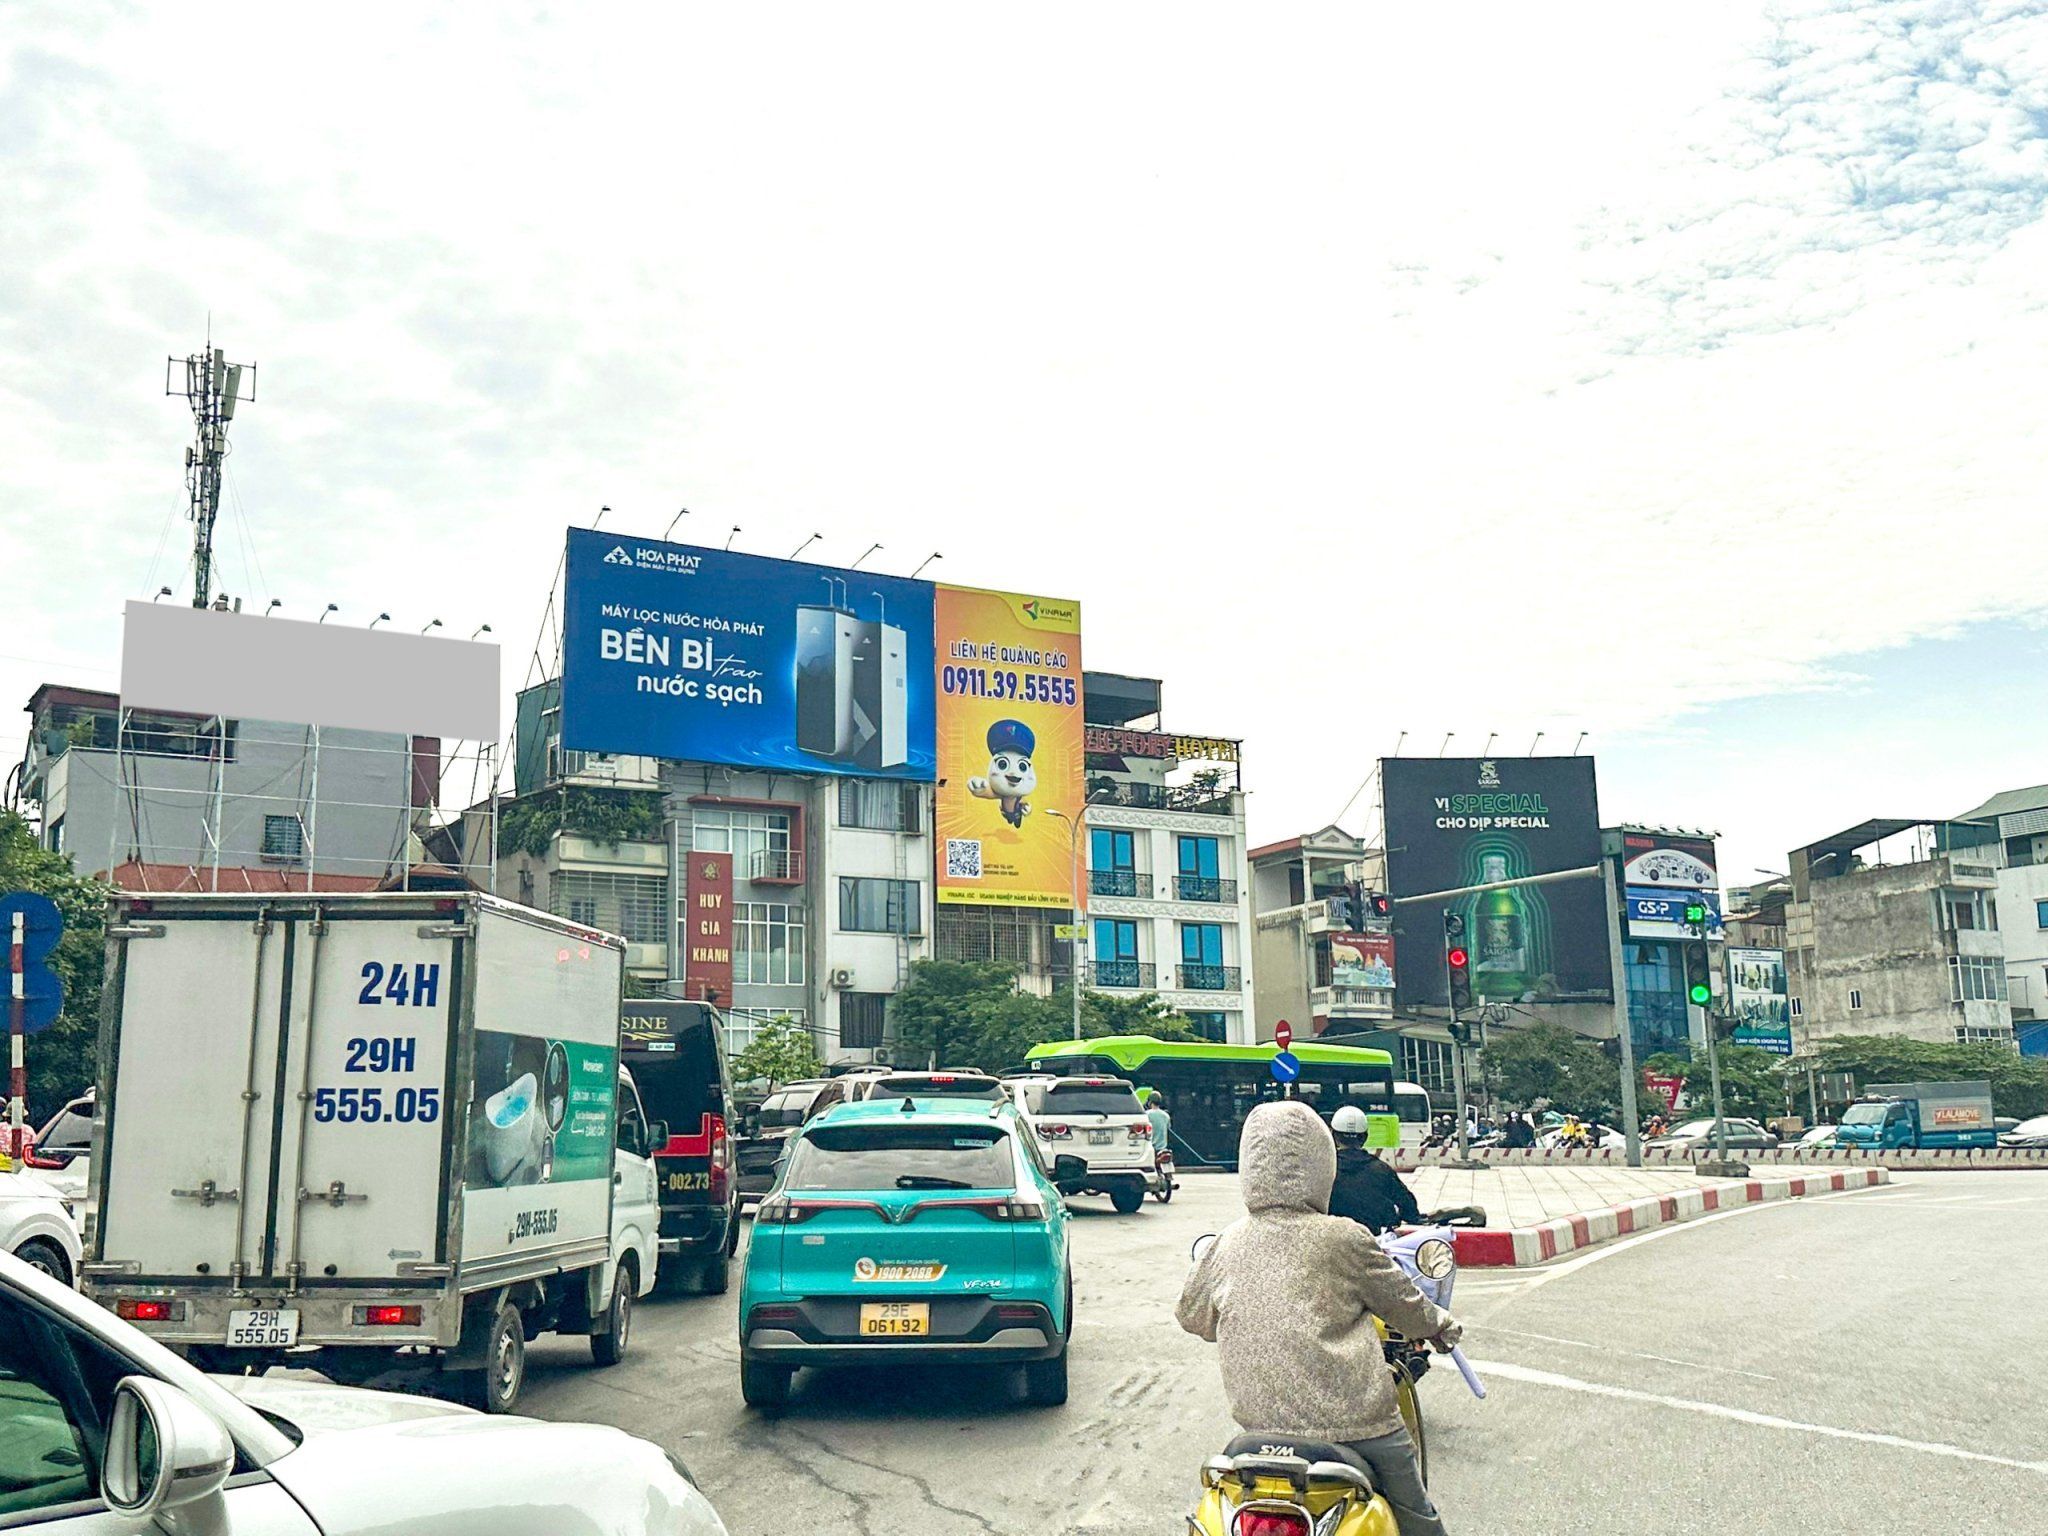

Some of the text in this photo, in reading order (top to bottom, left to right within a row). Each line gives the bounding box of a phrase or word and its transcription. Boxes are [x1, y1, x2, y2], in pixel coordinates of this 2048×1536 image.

[602, 603, 765, 637] MÁY LỌC NƯỚC HÒA PHÁT
[601, 626, 713, 671] BỀN BỈ
[950, 639, 1067, 669] LIÊN HỆ QUẢNG CÁO
[712, 653, 764, 680] trao
[637, 674, 763, 707] nước sạch
[942, 665, 1076, 706] 0911.39.5555
[1434, 793, 1549, 814] VỊ SPECIAL
[1435, 816, 1550, 832] CHO DỊP SPECIAL
[699, 893, 722, 909] HUY
[700, 920, 721, 935] GIA
[358, 961, 440, 1007] 24H
[344, 1037, 416, 1073] 29H
[314, 1087, 439, 1123] 555.05
[669, 1172, 710, 1190] 002.73
[515, 1207, 558, 1239] 29H-555.05
[877, 1266, 903, 1280] 1900
[248, 1311, 279, 1327] 29H
[868, 1318, 921, 1334] 061.92
[234, 1328, 290, 1344] 555.05
[1258, 1444, 1295, 1457] SYM
